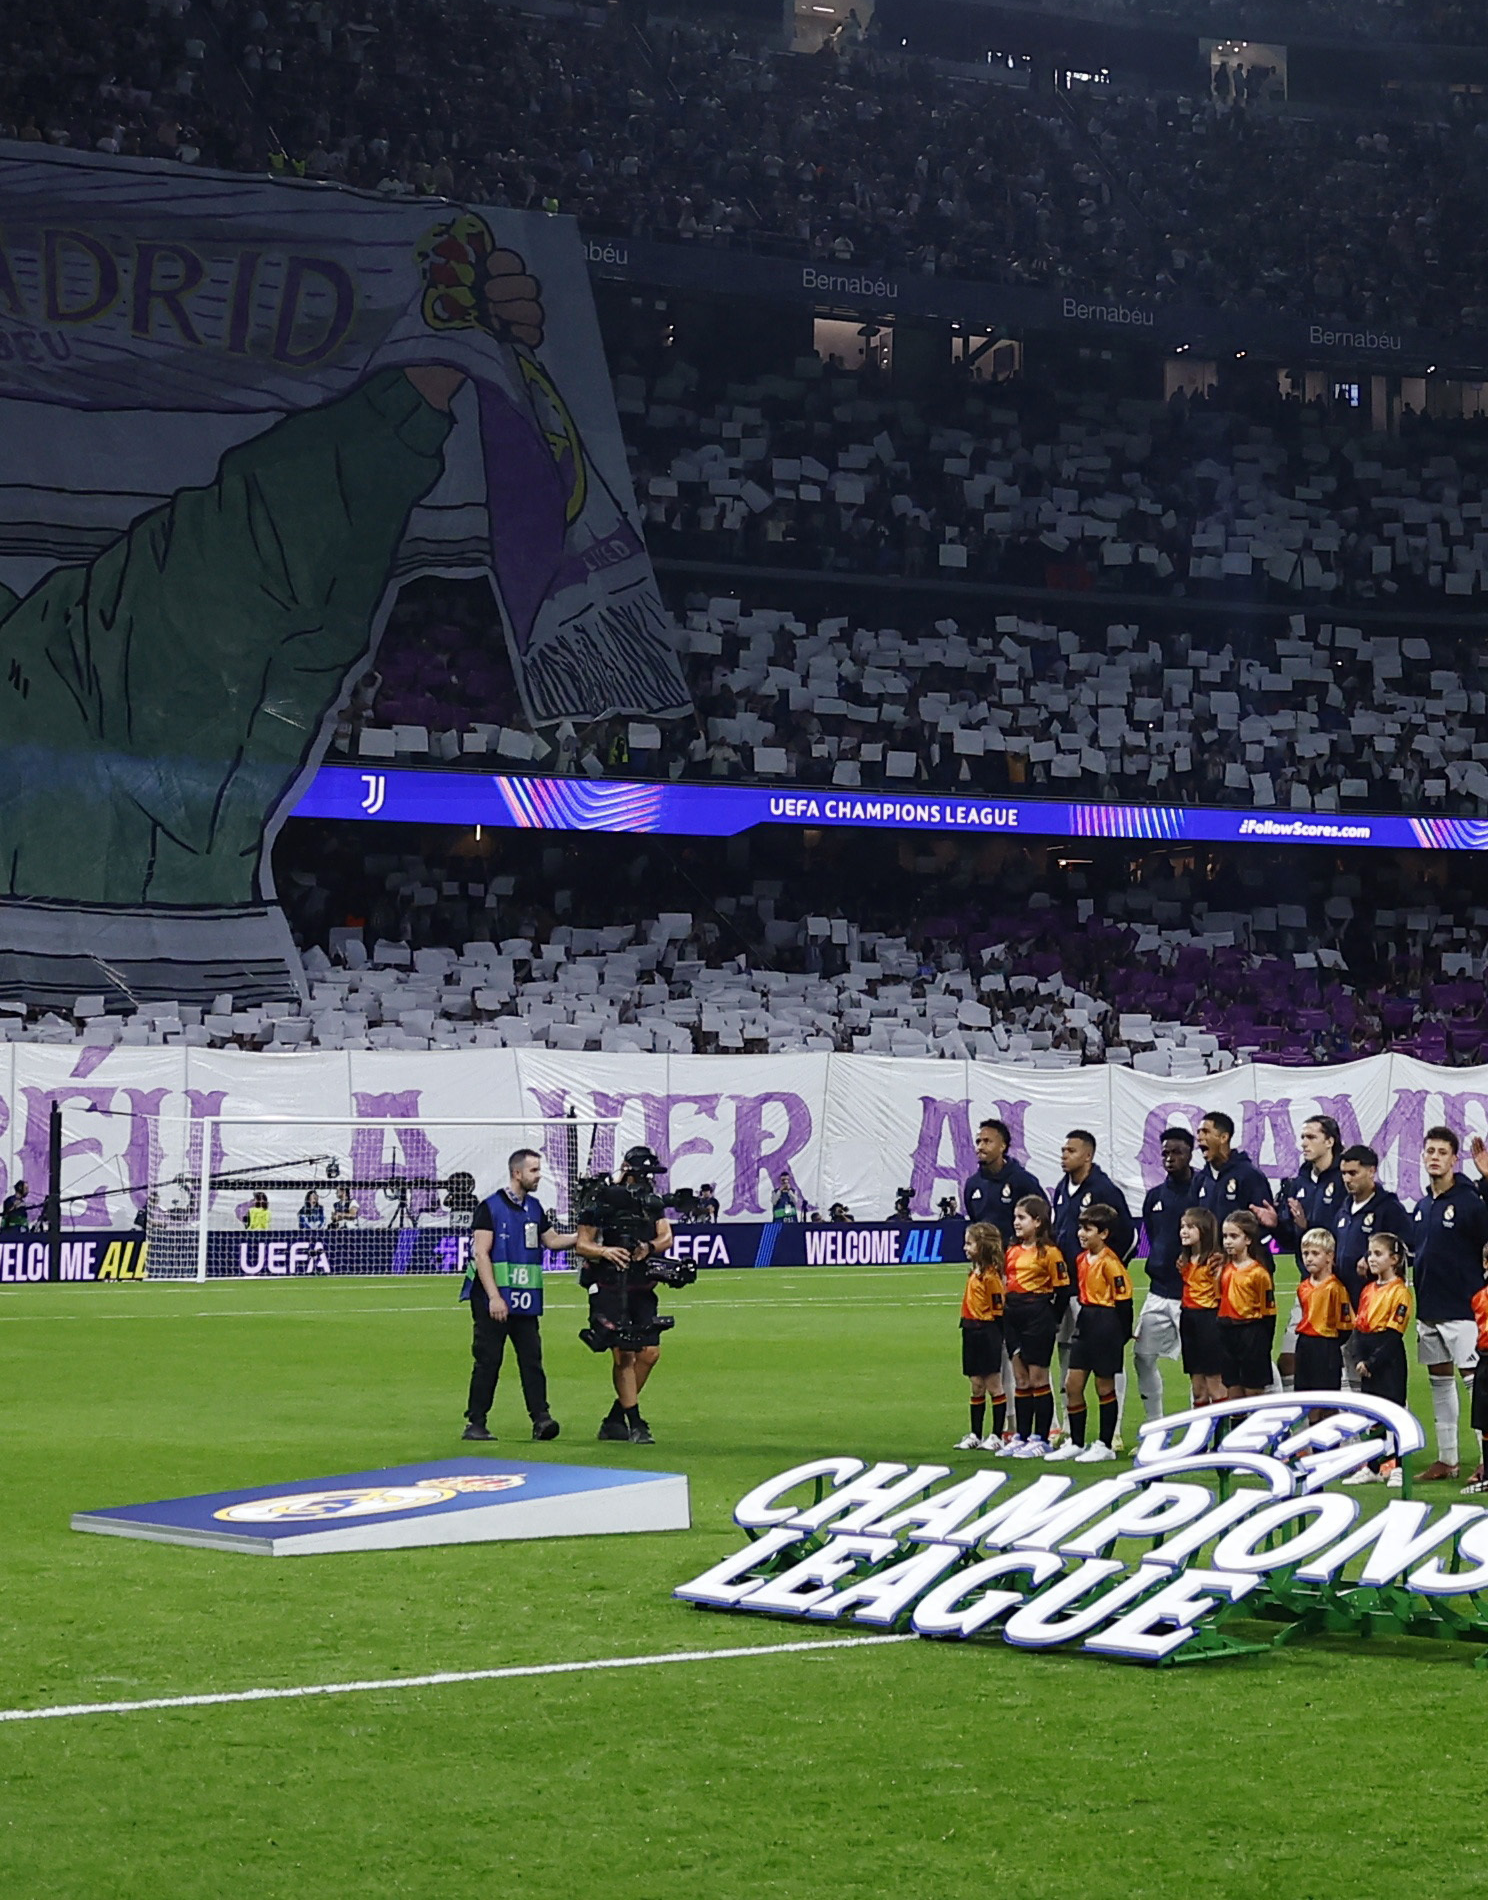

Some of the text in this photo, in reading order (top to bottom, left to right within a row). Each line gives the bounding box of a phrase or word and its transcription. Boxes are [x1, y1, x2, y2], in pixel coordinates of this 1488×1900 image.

[802, 268, 898, 299] Bernabéu
[1063, 298, 1154, 326] Bernabéu
[1309, 326, 1401, 351] Bernabéu
[770, 798, 1018, 826] UEFA CHAMPIONS LEAGUE
[1246, 820, 1371, 839] FollowScores.com
[349, 1089, 448, 1221] A
[527, 1087, 818, 1222] VER
[98, 1241, 149, 1280] ALL
[239, 1242, 331, 1274] UEFA
[665, 1234, 730, 1265] EFA
[805, 1229, 943, 1265] WELCOME ALL
[511, 1292, 531, 1310] 50
[1136, 1404, 1396, 1497] UEFA
[672, 1528, 1260, 1660] LEAGUE
